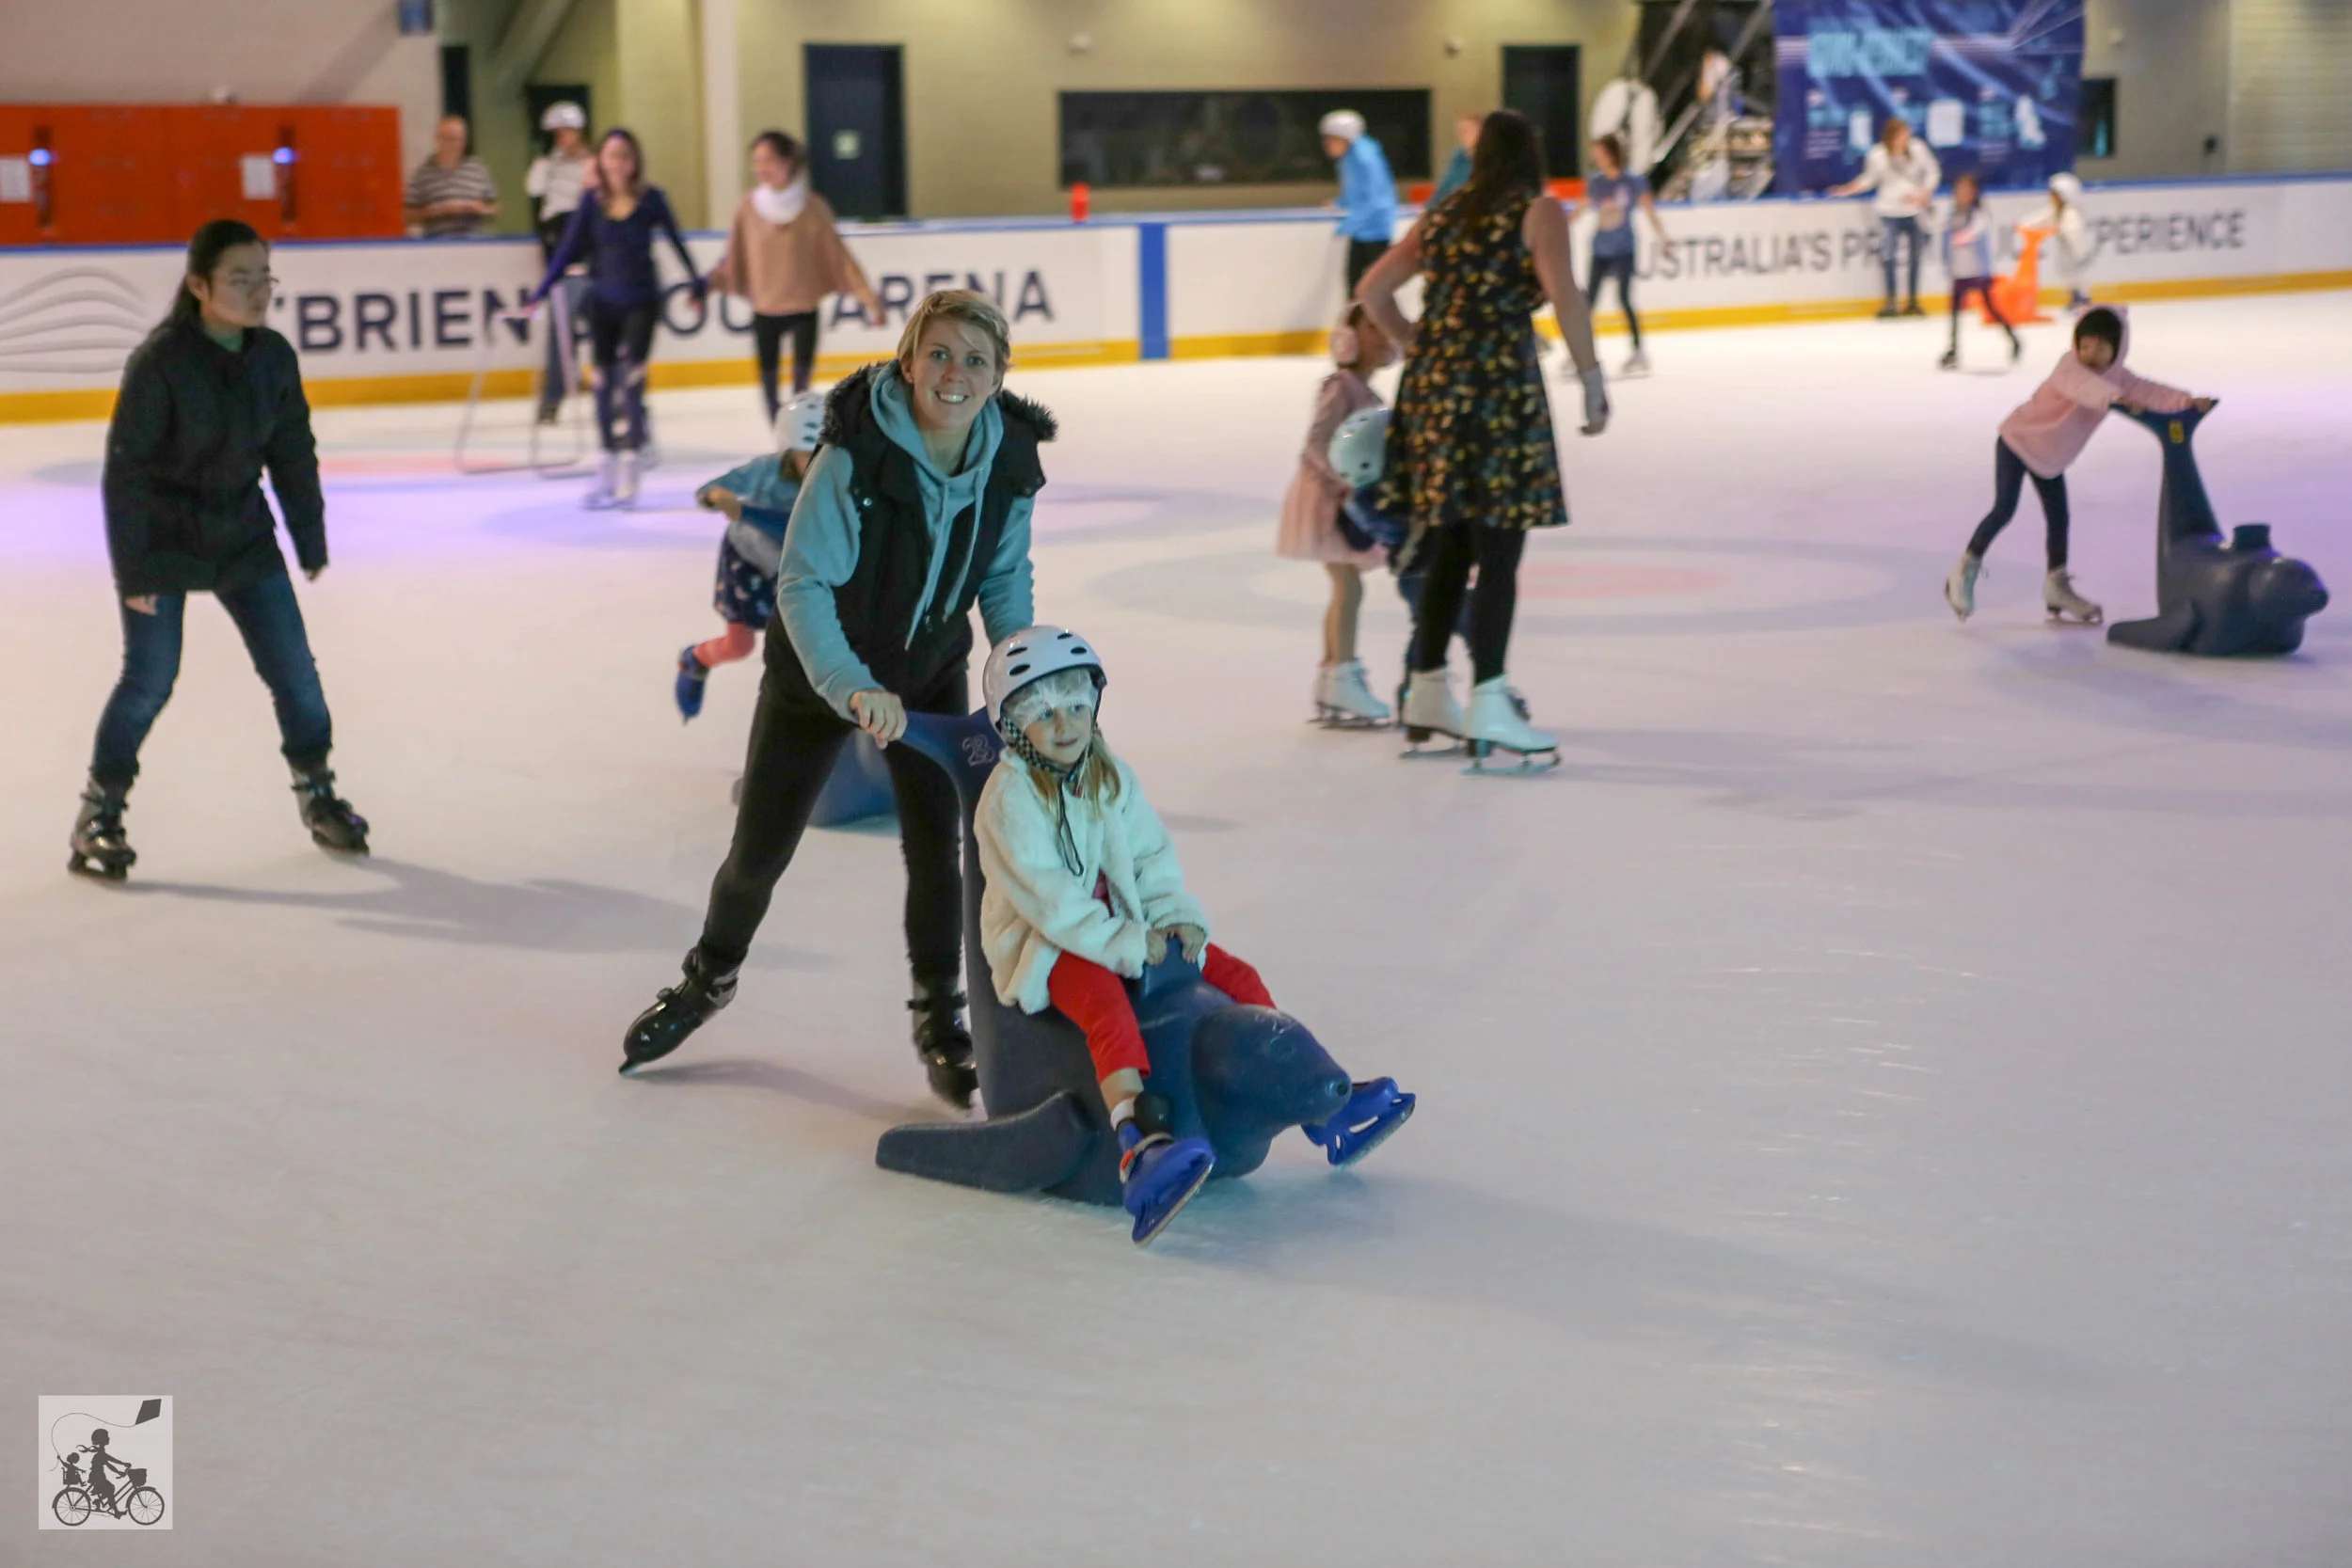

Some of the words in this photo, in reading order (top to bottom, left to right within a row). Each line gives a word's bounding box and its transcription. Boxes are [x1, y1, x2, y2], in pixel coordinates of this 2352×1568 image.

[1636, 230, 1833, 279] USTRALIA'S
[2087, 209, 2247, 255] PERIENCE
[273, 288, 530, 353] 'BRIEN
